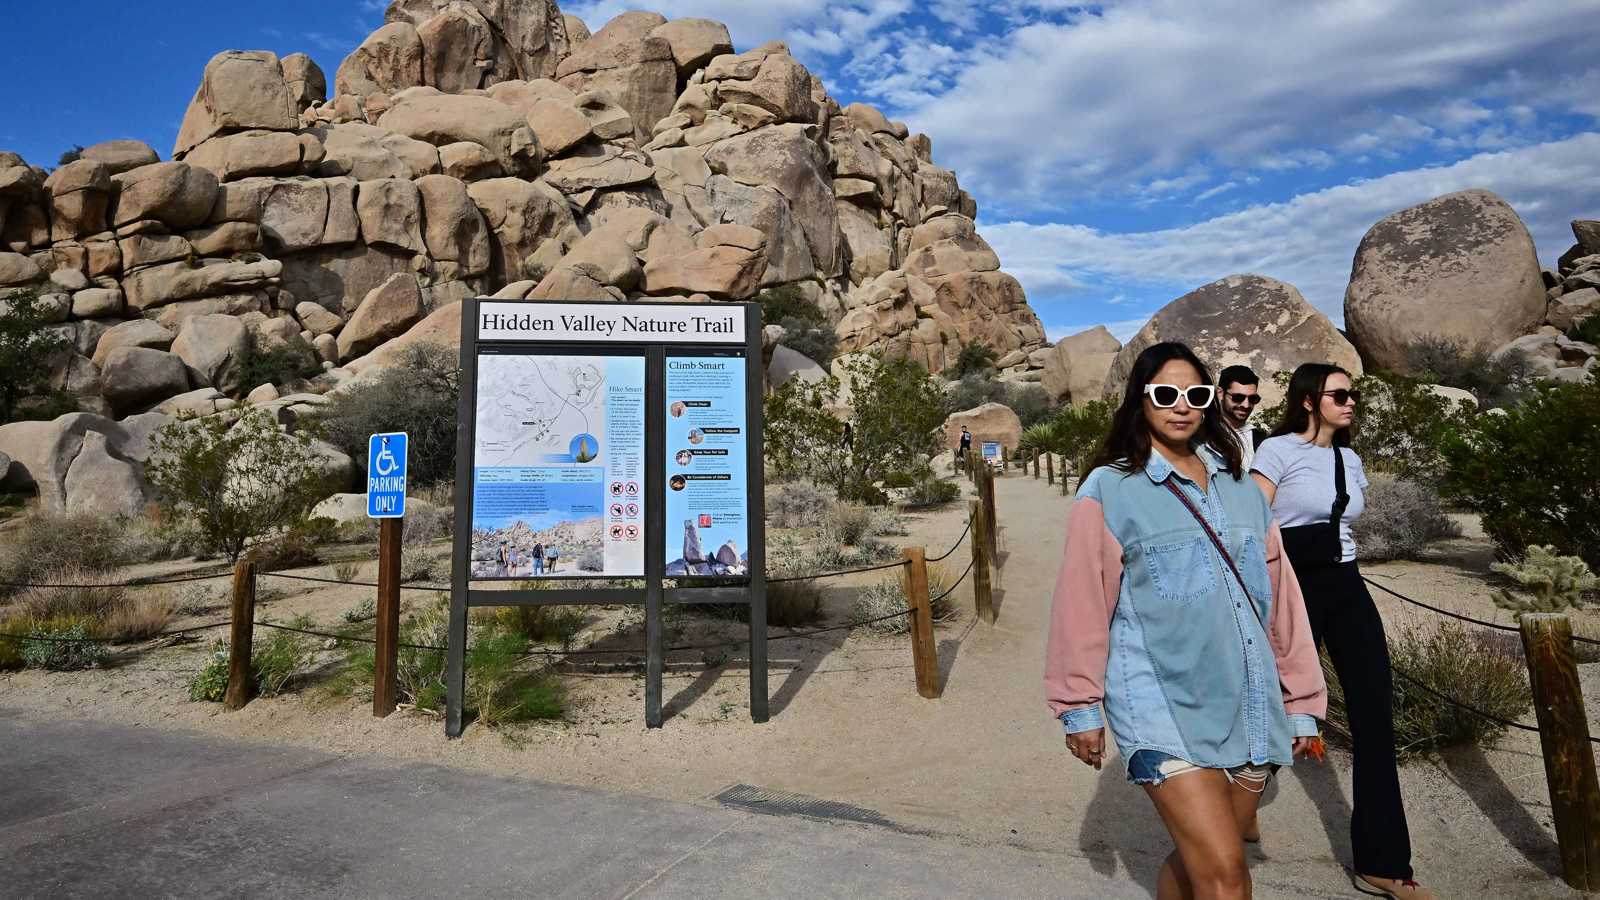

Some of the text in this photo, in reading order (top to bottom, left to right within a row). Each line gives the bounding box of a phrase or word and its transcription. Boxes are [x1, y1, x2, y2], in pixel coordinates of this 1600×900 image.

[481, 313, 734, 337] Hidden Valley Nature Trail
[669, 361, 725, 370] Climb Smart
[370, 476, 404, 493] PARKING
[375, 495, 397, 512] ONLY
